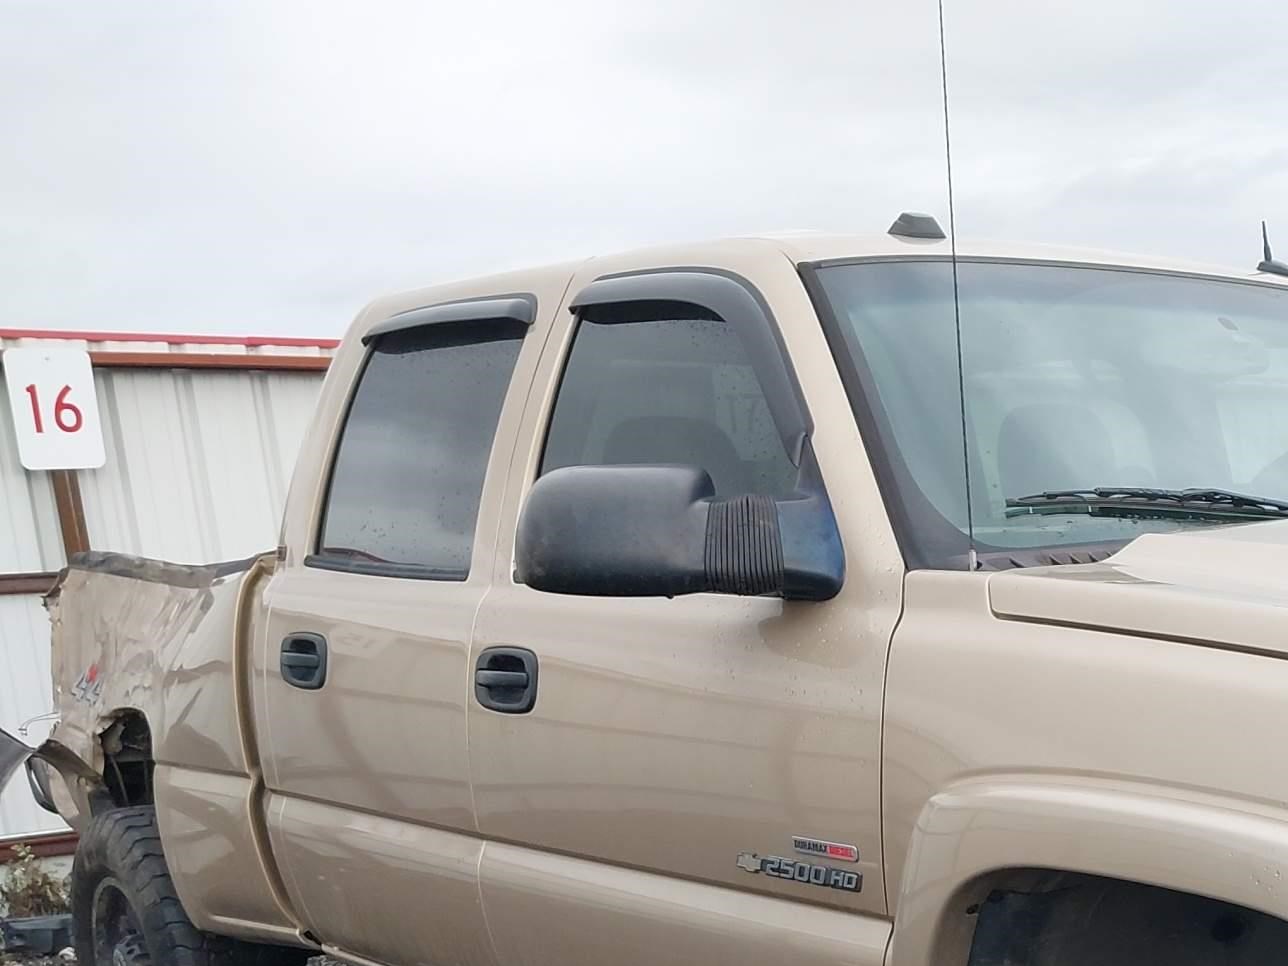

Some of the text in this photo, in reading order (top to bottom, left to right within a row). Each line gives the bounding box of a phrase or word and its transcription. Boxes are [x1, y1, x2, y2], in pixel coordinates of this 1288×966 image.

[25, 384, 83, 433] 16
[766, 857, 859, 889] 2500 HD
